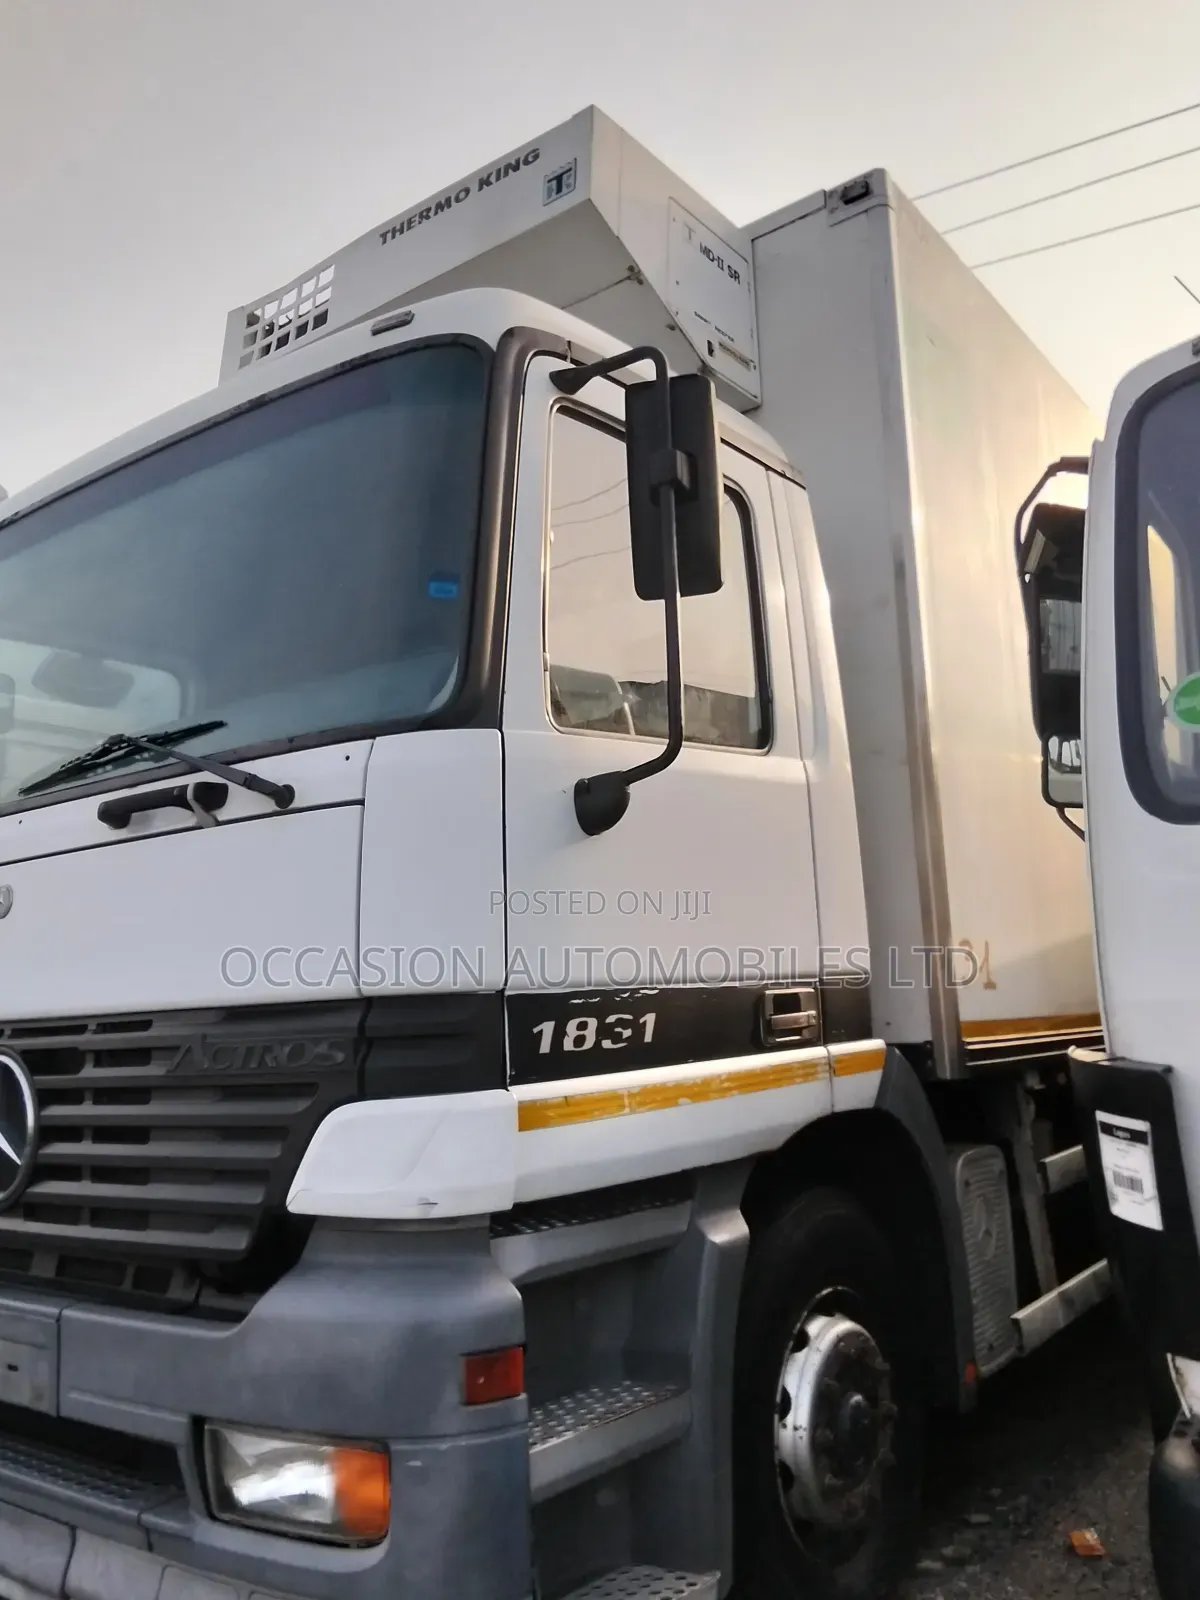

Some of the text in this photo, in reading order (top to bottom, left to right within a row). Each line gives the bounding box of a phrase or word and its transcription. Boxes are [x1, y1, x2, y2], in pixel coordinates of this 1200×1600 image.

[379, 148, 541, 246] THERMO KING
[727, 264, 741, 285] SR
[532, 1012, 657, 1054] 1831
